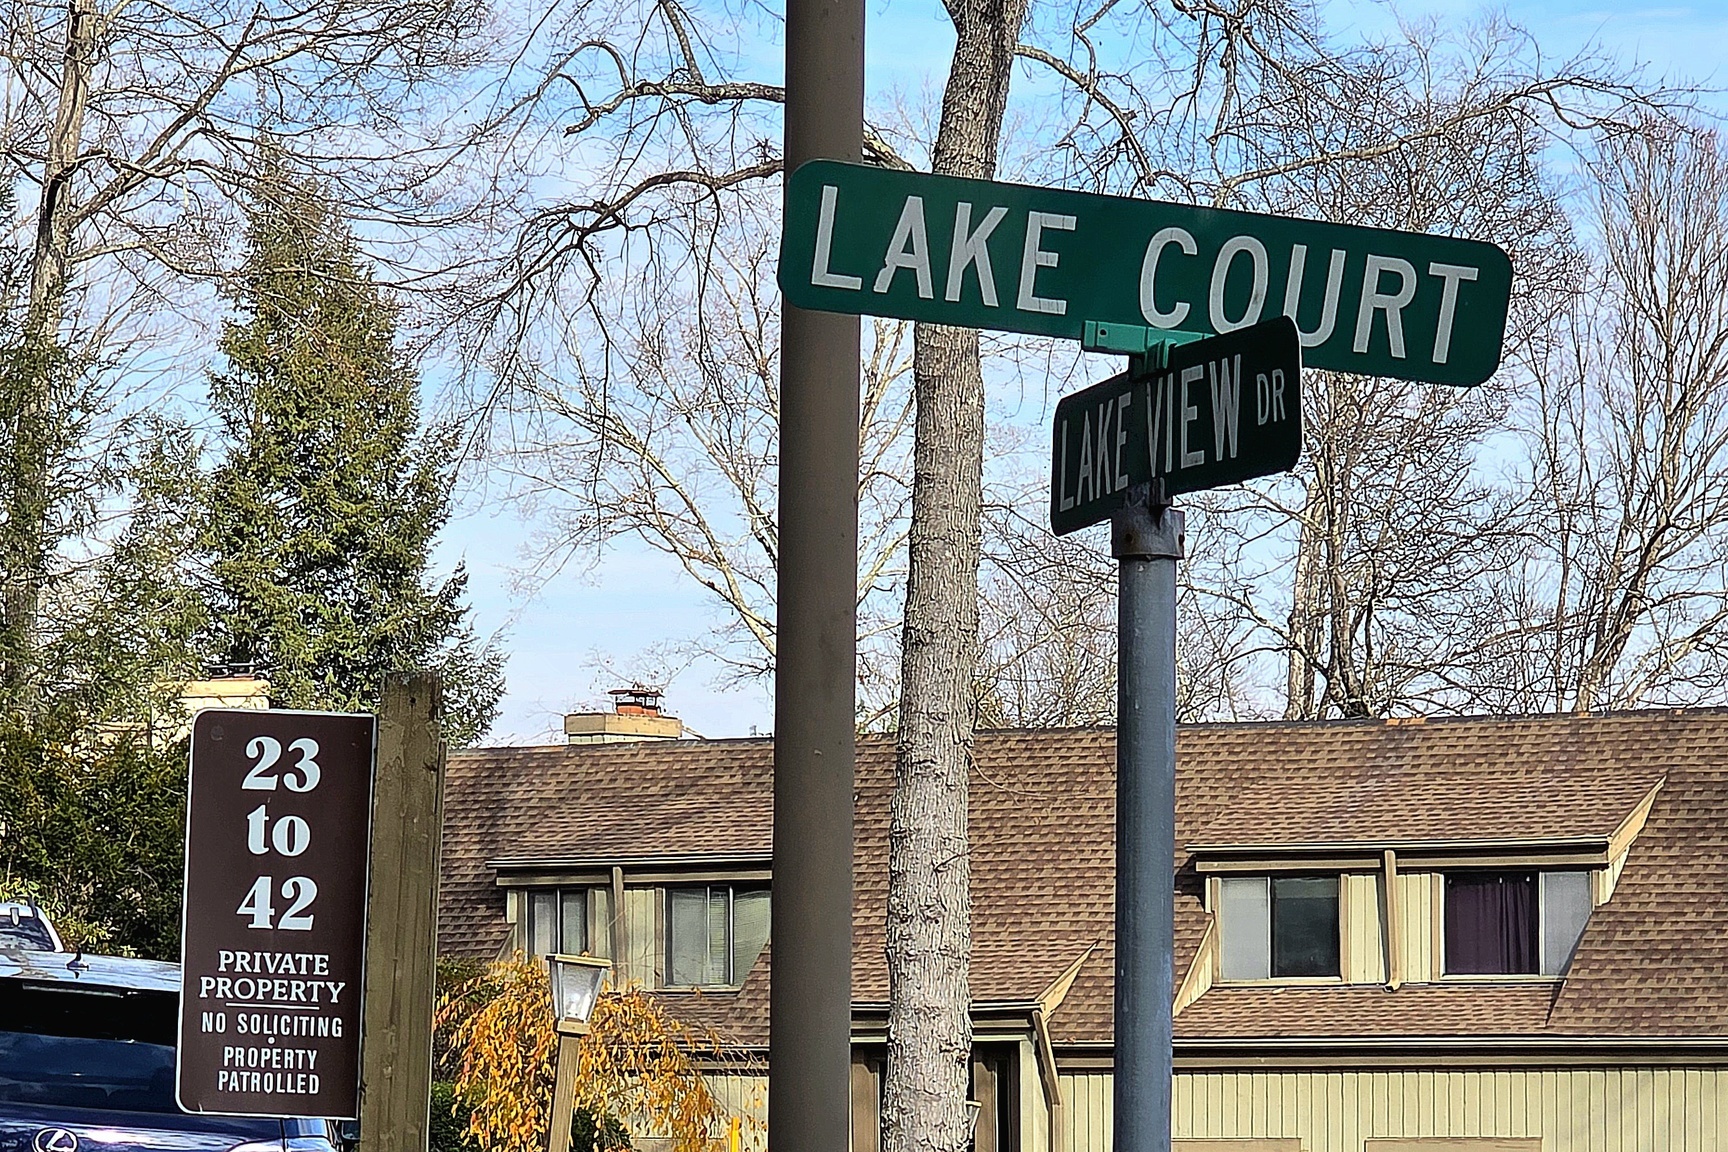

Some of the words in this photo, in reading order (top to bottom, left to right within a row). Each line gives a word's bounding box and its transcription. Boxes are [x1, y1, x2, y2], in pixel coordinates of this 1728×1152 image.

[810, 185, 1077, 315] LAKE
[1140, 226, 1479, 365] COURT
[1059, 391, 1131, 513] LAKE
[1146, 354, 1241, 478] VIEW
[1256, 368, 1286, 426] DR
[241, 736, 321, 793] 23
[246, 804, 311, 857] to
[236, 876, 318, 931] 42
[218, 950, 329, 977] PRIVATE
[199, 976, 346, 1004] PROPERTY
[201, 1011, 226, 1034] NO
[237, 1013, 342, 1038] SOLICITING
[224, 1046, 317, 1070] PROPERTY
[218, 1072, 320, 1095] PATROLLED
